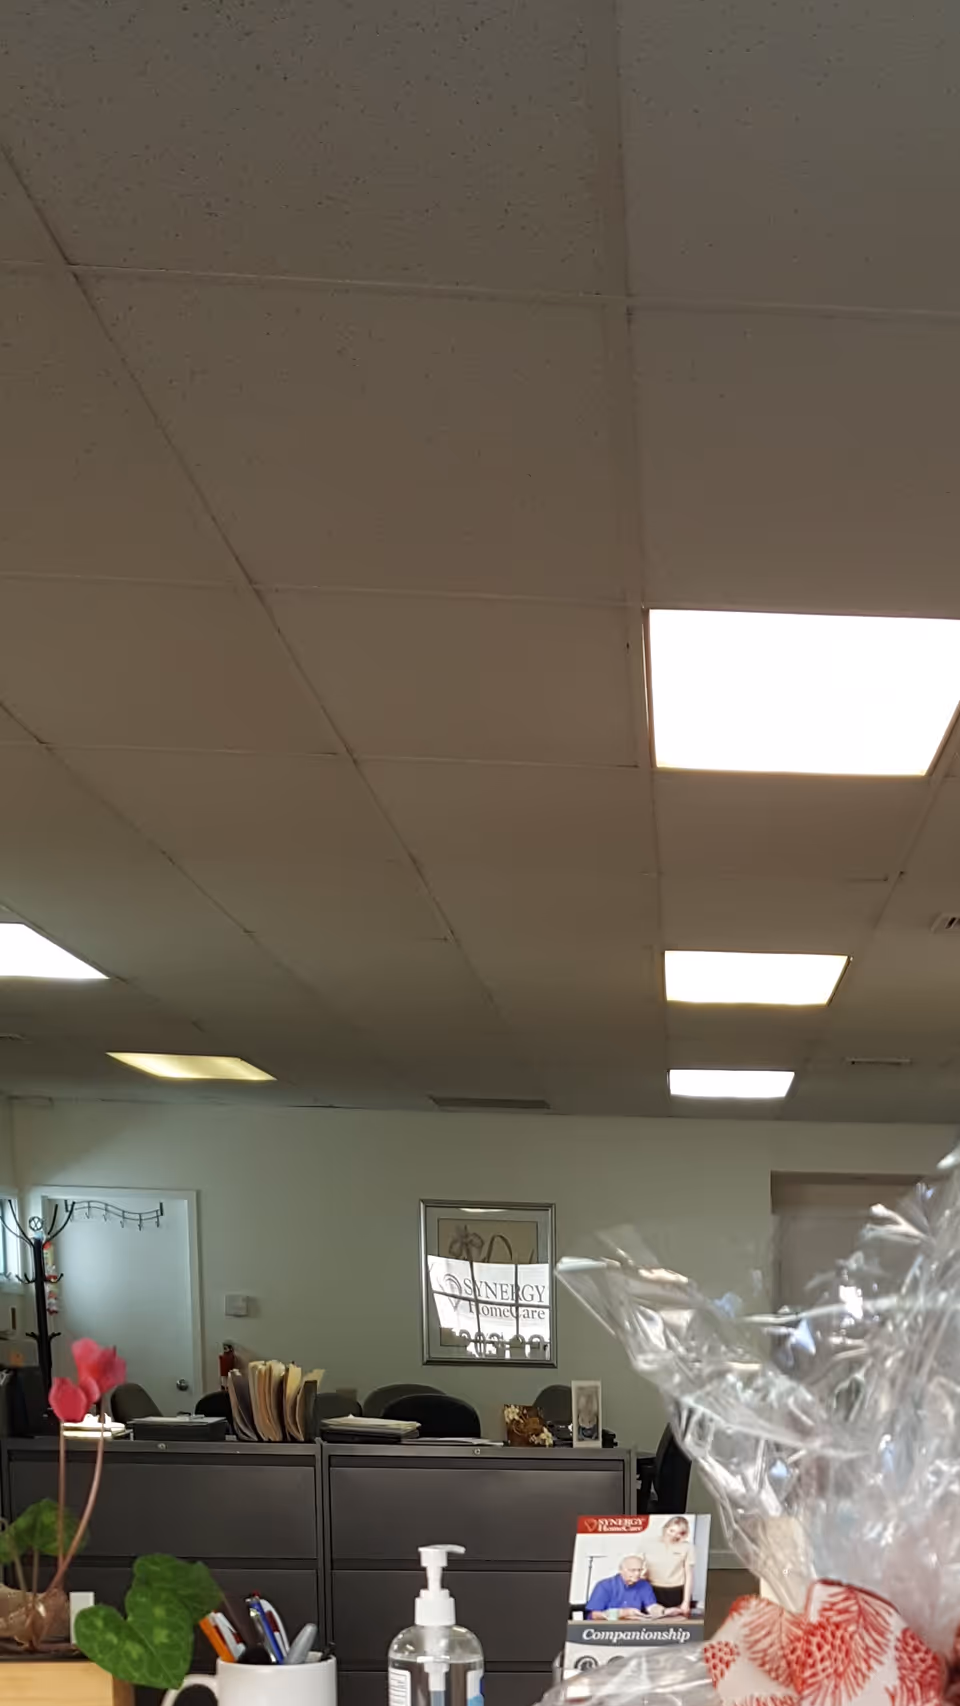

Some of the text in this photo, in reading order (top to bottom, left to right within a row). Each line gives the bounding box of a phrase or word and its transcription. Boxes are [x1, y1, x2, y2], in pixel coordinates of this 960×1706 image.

[463, 1278, 546, 1303] SYNERGY
[469, 1300, 546, 1319] HomeCare
[598, 1518, 642, 1526] SYNERGY
[582, 1628, 690, 1643] Companionship
